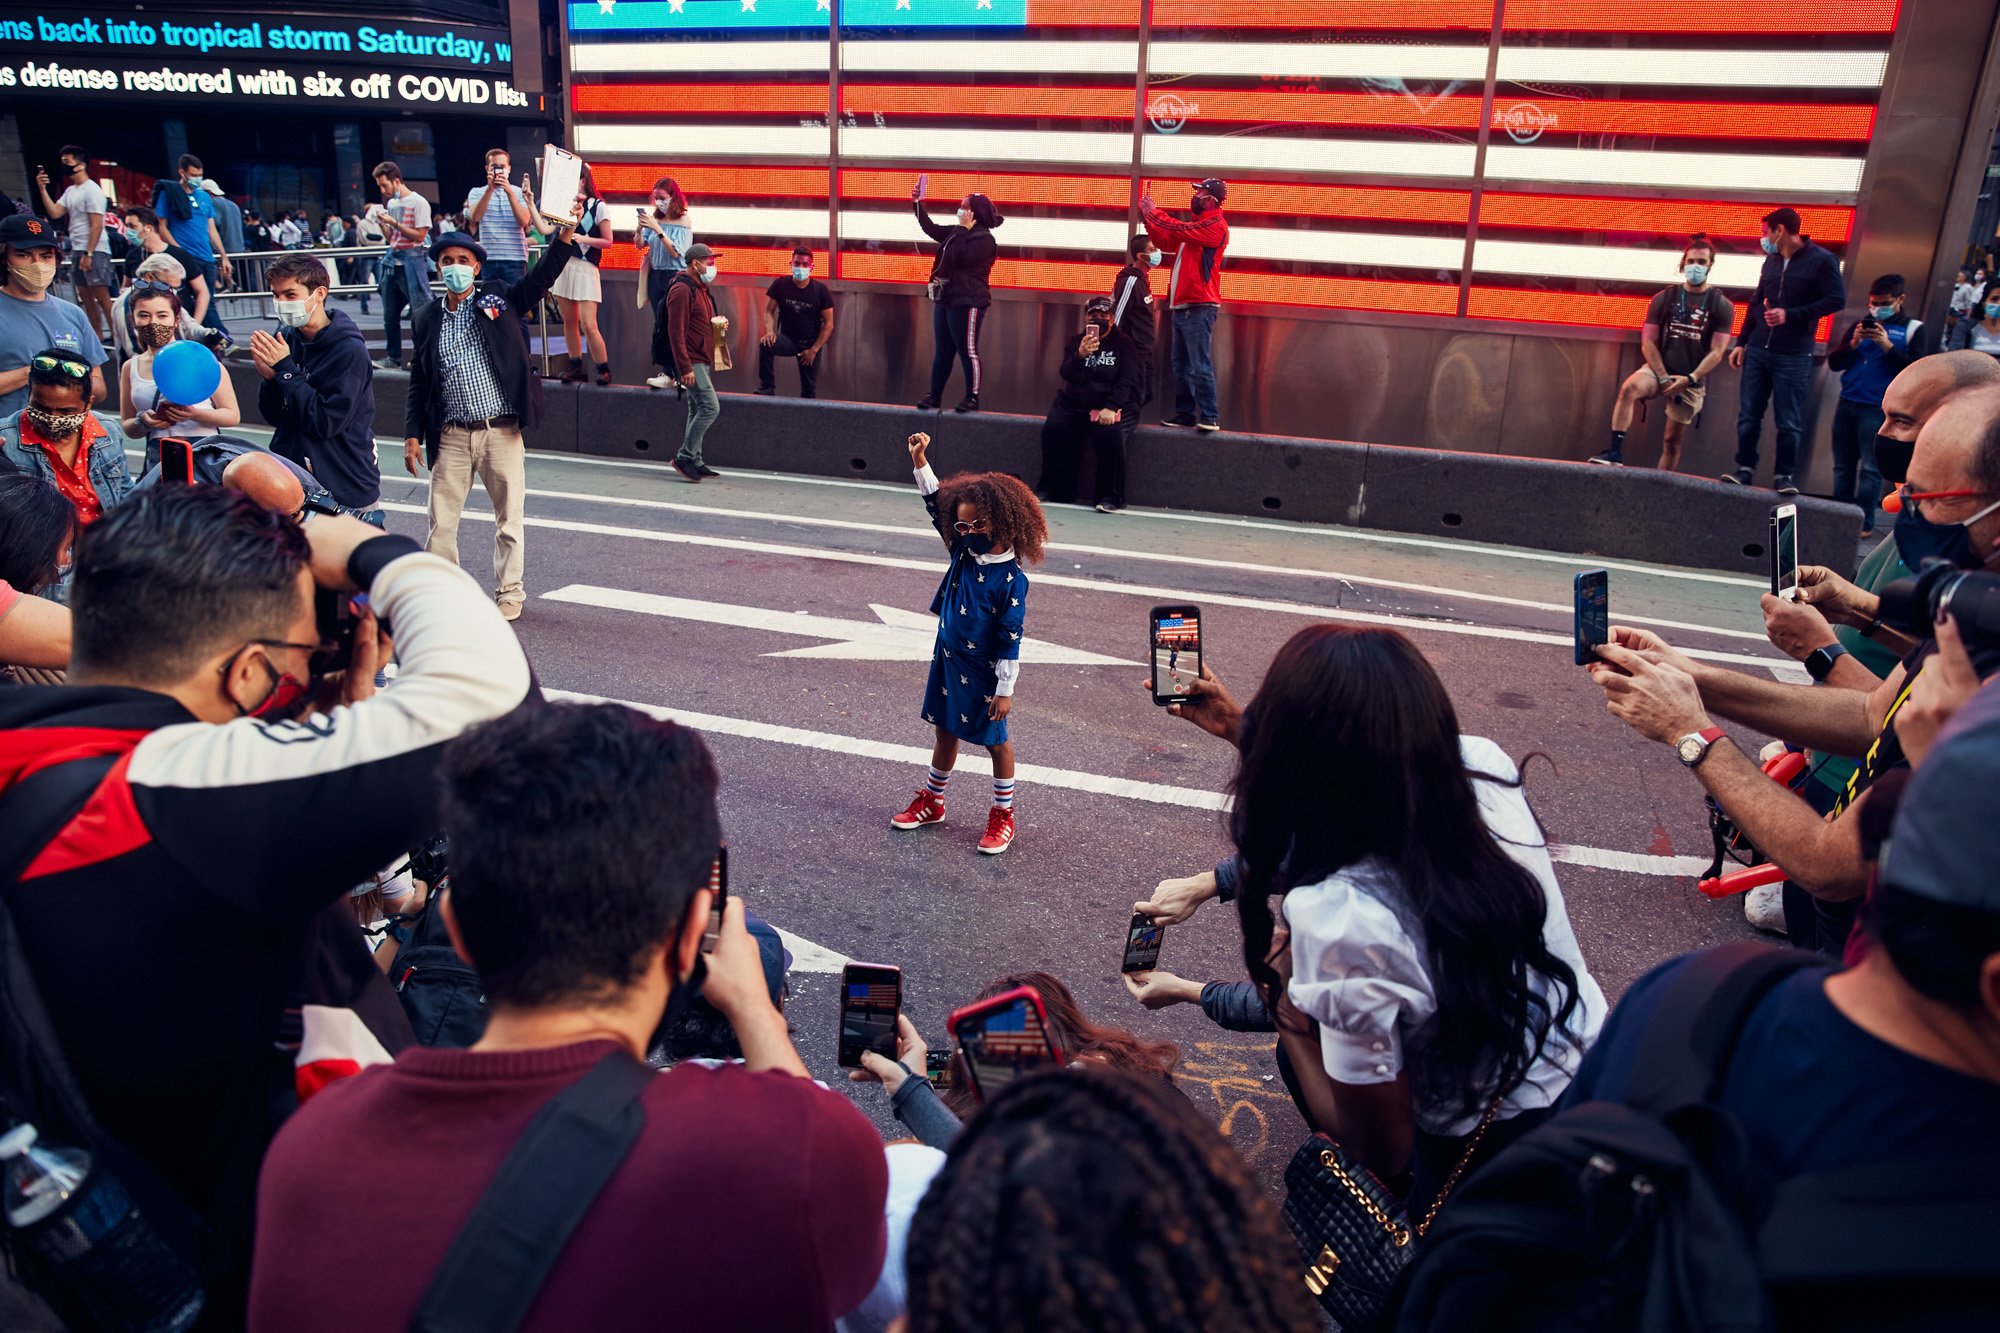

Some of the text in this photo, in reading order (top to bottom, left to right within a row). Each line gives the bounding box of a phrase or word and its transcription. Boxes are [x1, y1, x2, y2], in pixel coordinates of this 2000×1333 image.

[37, 15, 103, 43] back
[105, 18, 157, 46] into
[161, 21, 262, 52] tropical
[267, 25, 352, 52] storm
[357, 26, 491, 65] Saturday,
[0, 66, 17, 87] s
[20, 61, 119, 90] defense
[122, 67, 233, 93] restored
[236, 69, 298, 96] with
[302, 71, 346, 98] six
[350, 73, 392, 99] off
[397, 74, 490, 104] COVID
